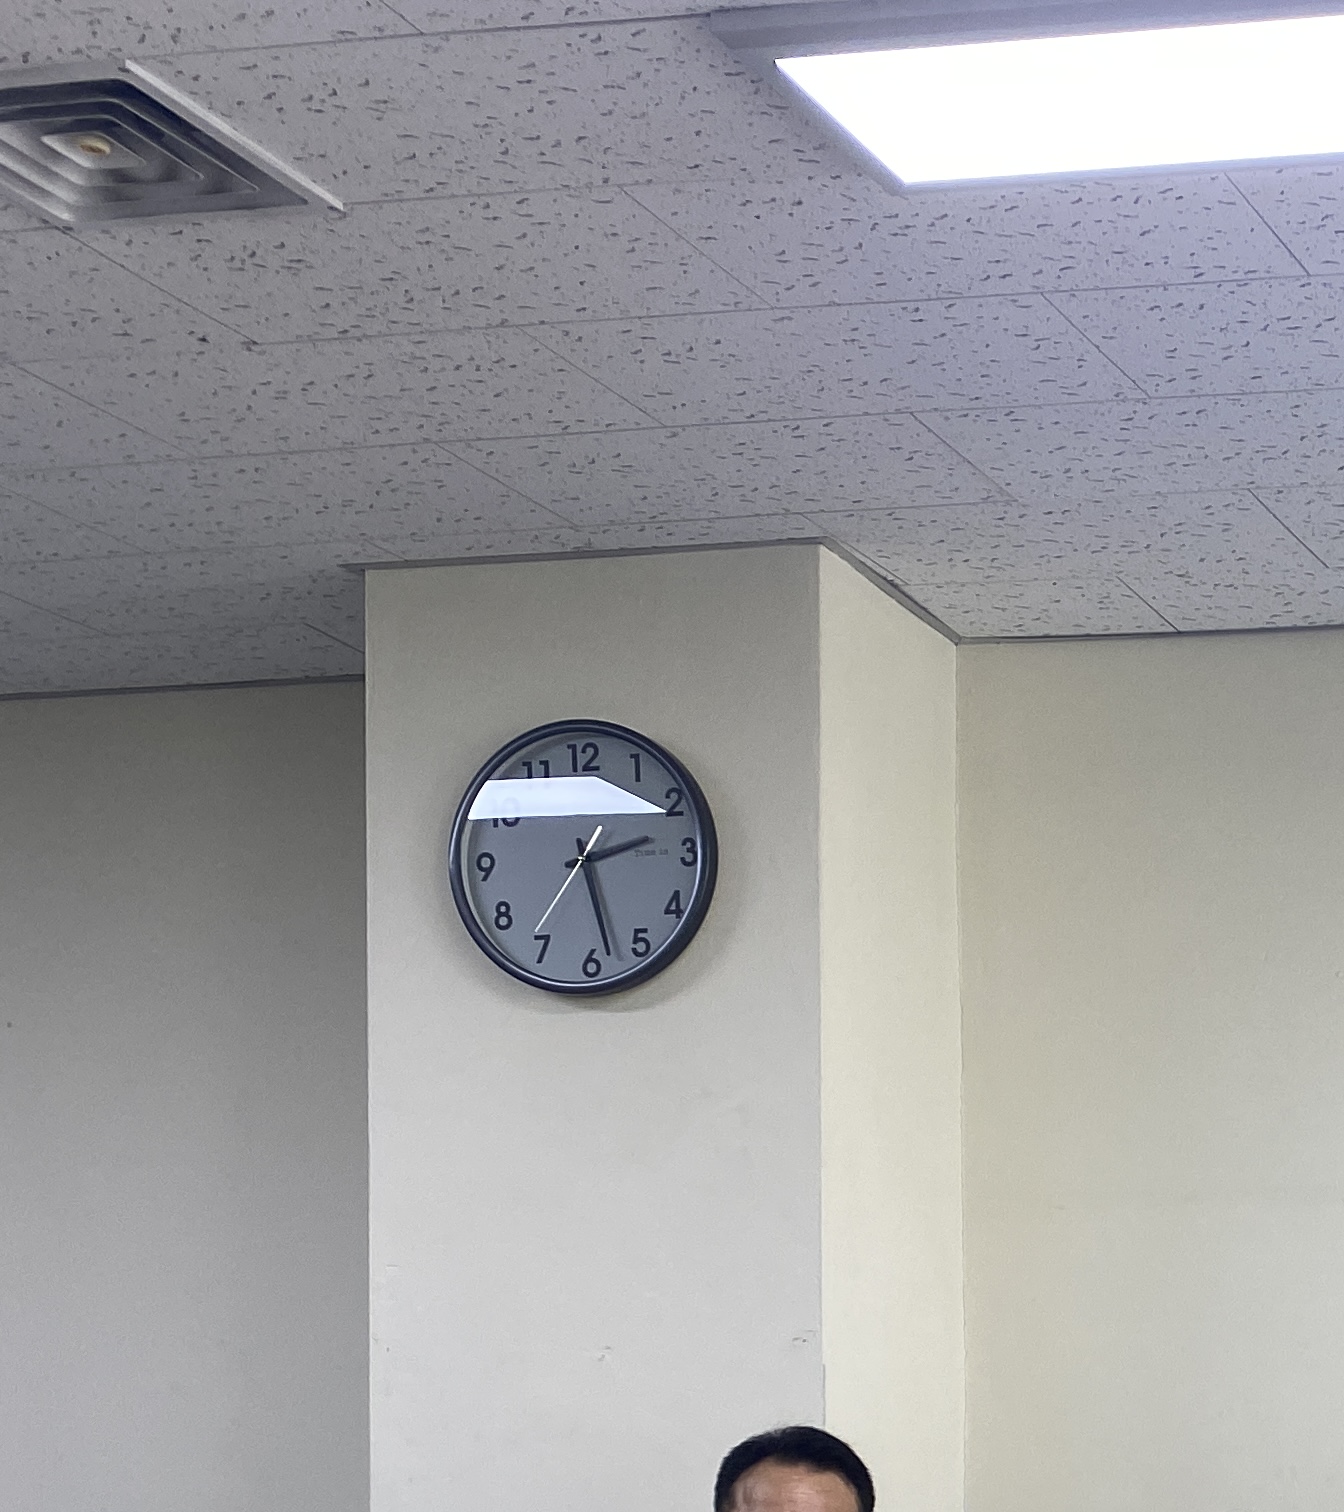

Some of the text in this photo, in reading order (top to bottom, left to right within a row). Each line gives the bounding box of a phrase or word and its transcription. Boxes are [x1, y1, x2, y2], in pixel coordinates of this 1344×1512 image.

[567, 742, 600, 773] 12
[629, 753, 641, 782] 1
[665, 787, 684, 817] 2
[680, 837, 698, 867] 3
[476, 852, 495, 882] 9
[494, 901, 513, 930] 8
[664, 890, 684, 919] 4
[534, 935, 551, 964] 7
[631, 928, 651, 957] 5
[582, 949, 601, 978] 6
